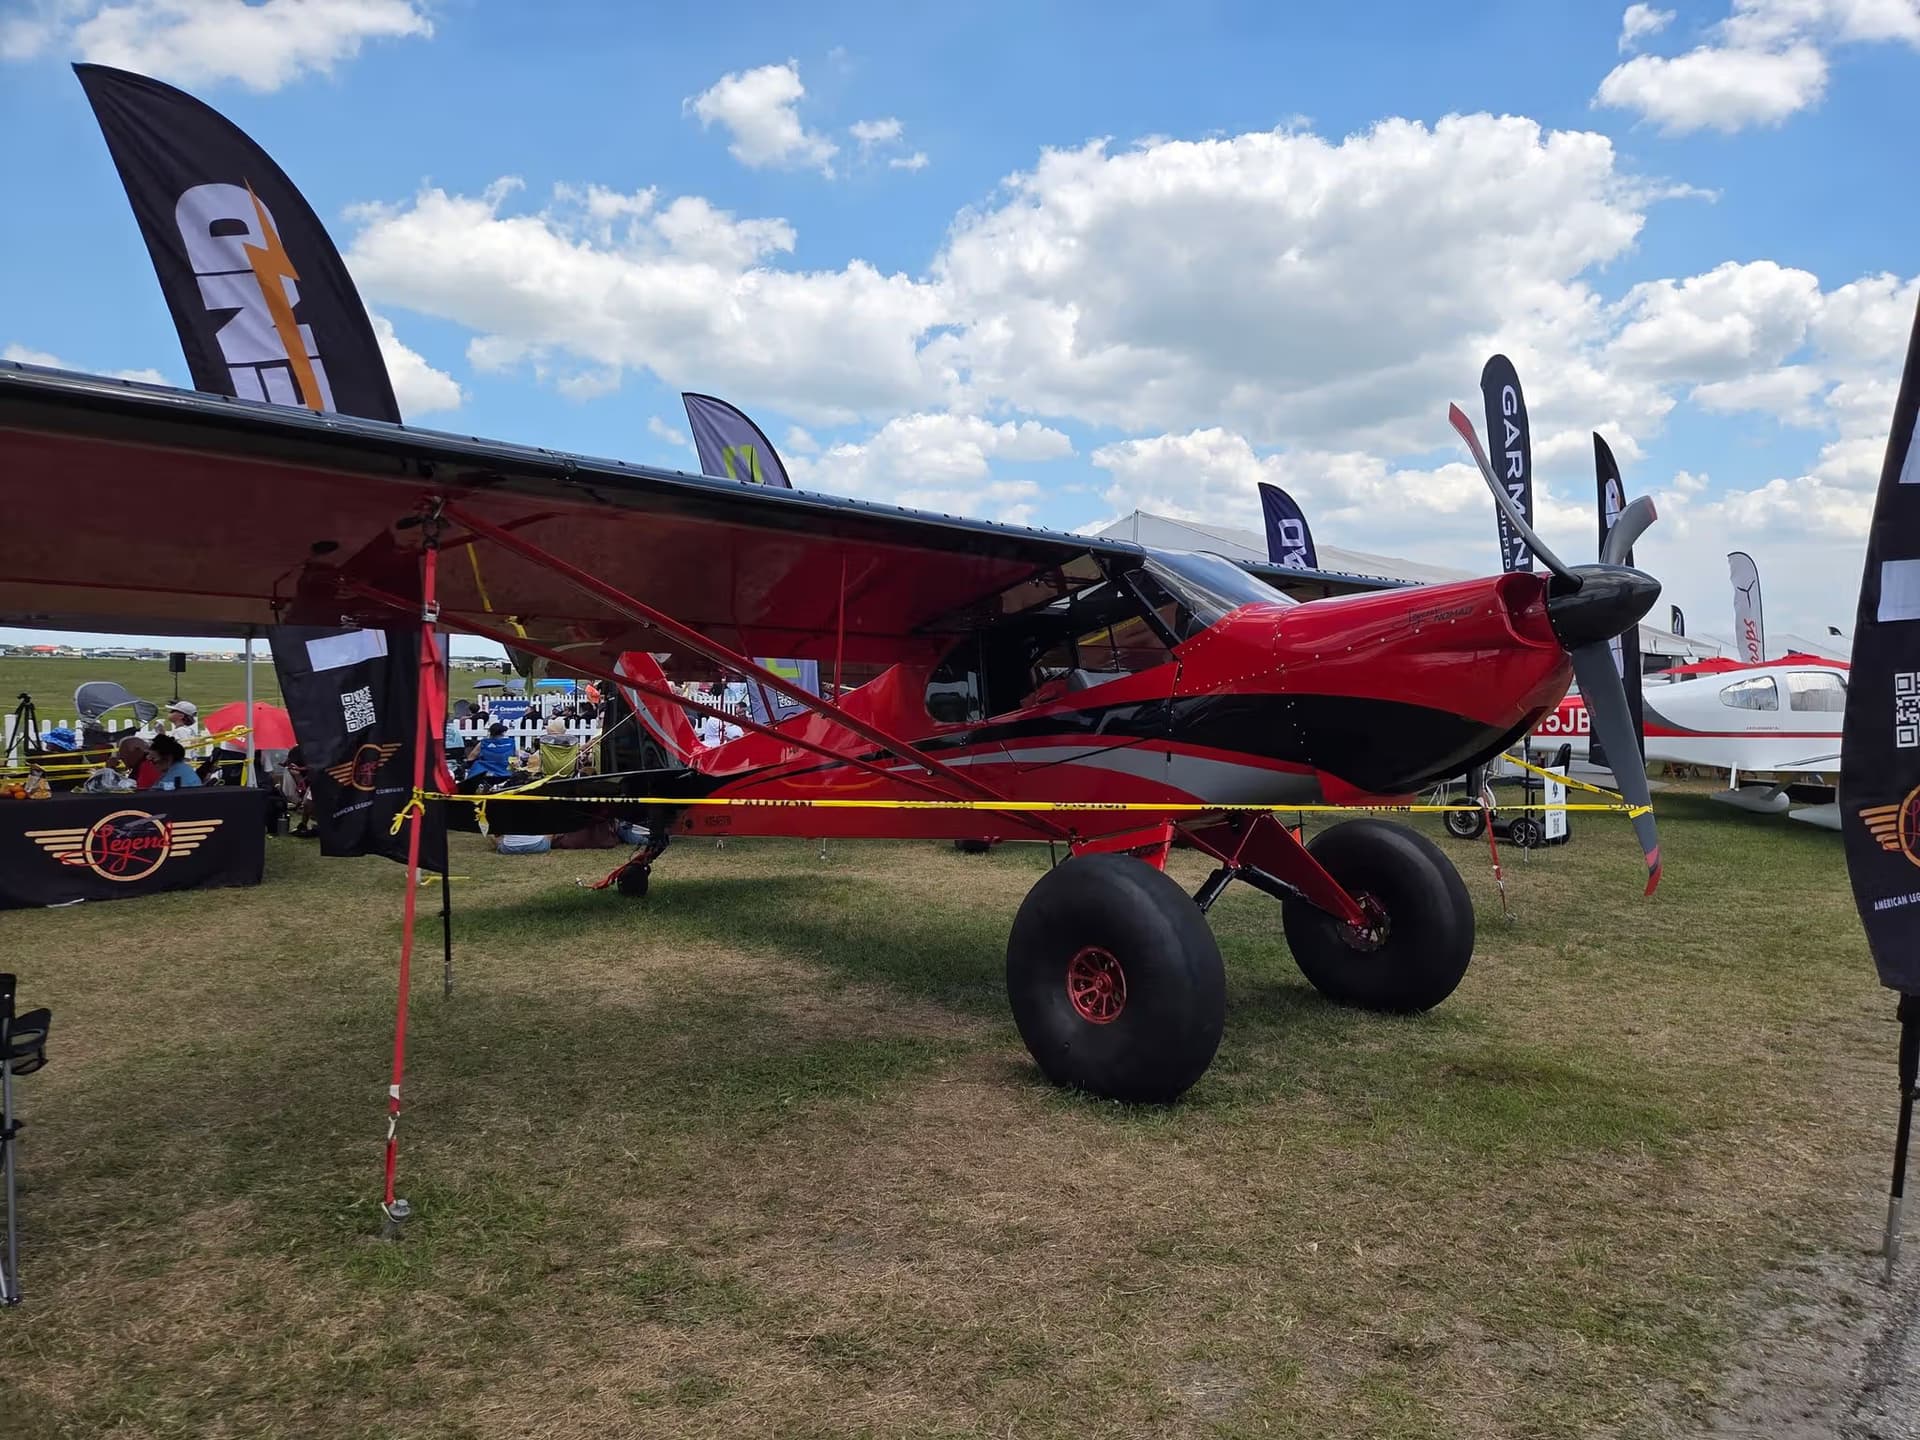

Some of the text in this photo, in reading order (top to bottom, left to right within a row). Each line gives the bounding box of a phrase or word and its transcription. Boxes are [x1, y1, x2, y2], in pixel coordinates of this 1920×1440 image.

[1502, 384, 1529, 567] GARMN
[60, 821, 173, 872] Legend
[1874, 895, 1908, 911] AMERICAN
